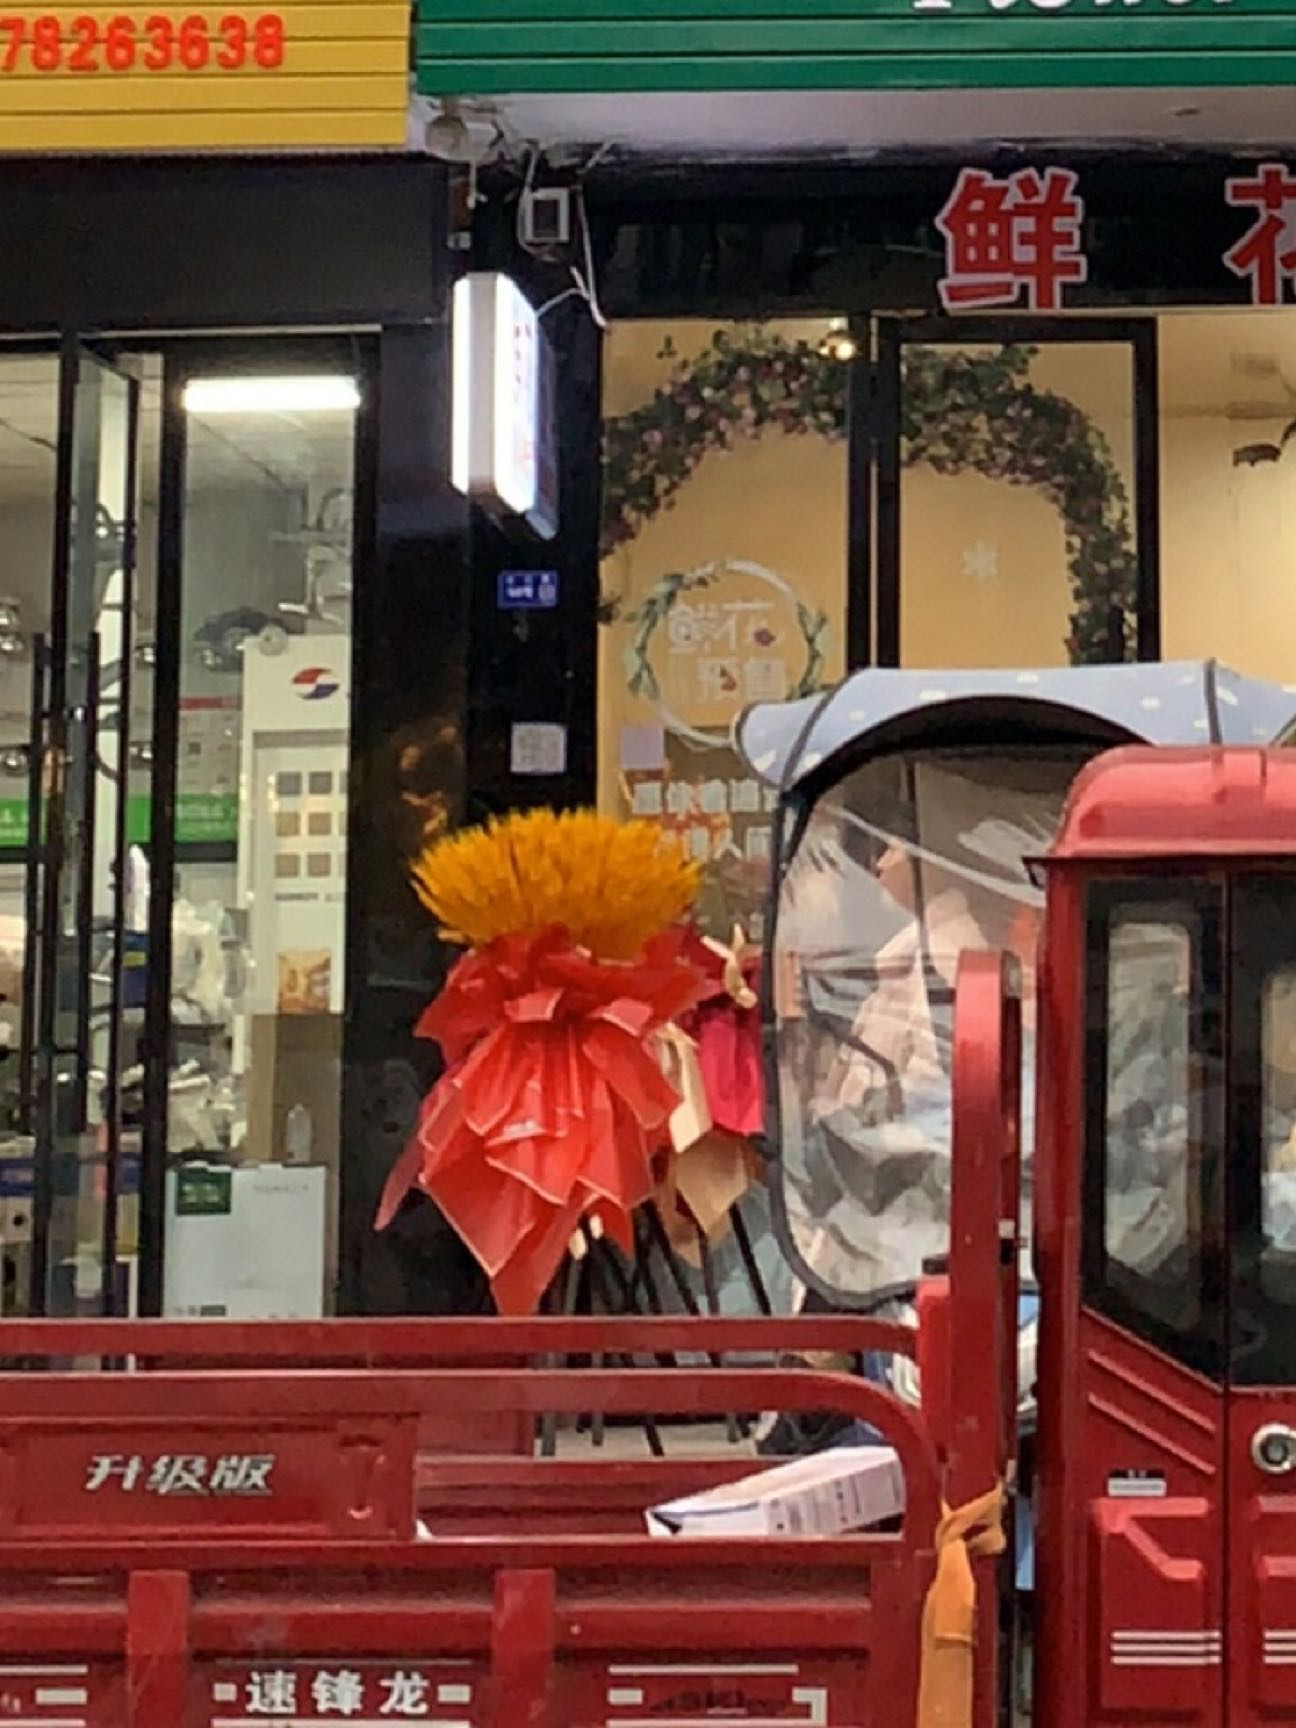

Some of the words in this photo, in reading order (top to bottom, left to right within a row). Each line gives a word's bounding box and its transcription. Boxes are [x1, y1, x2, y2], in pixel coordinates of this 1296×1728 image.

[0, 15, 287, 73] 78263638
[85, 1455, 276, 1494] 升级版
[245, 1670, 430, 1714] 速锋龙
